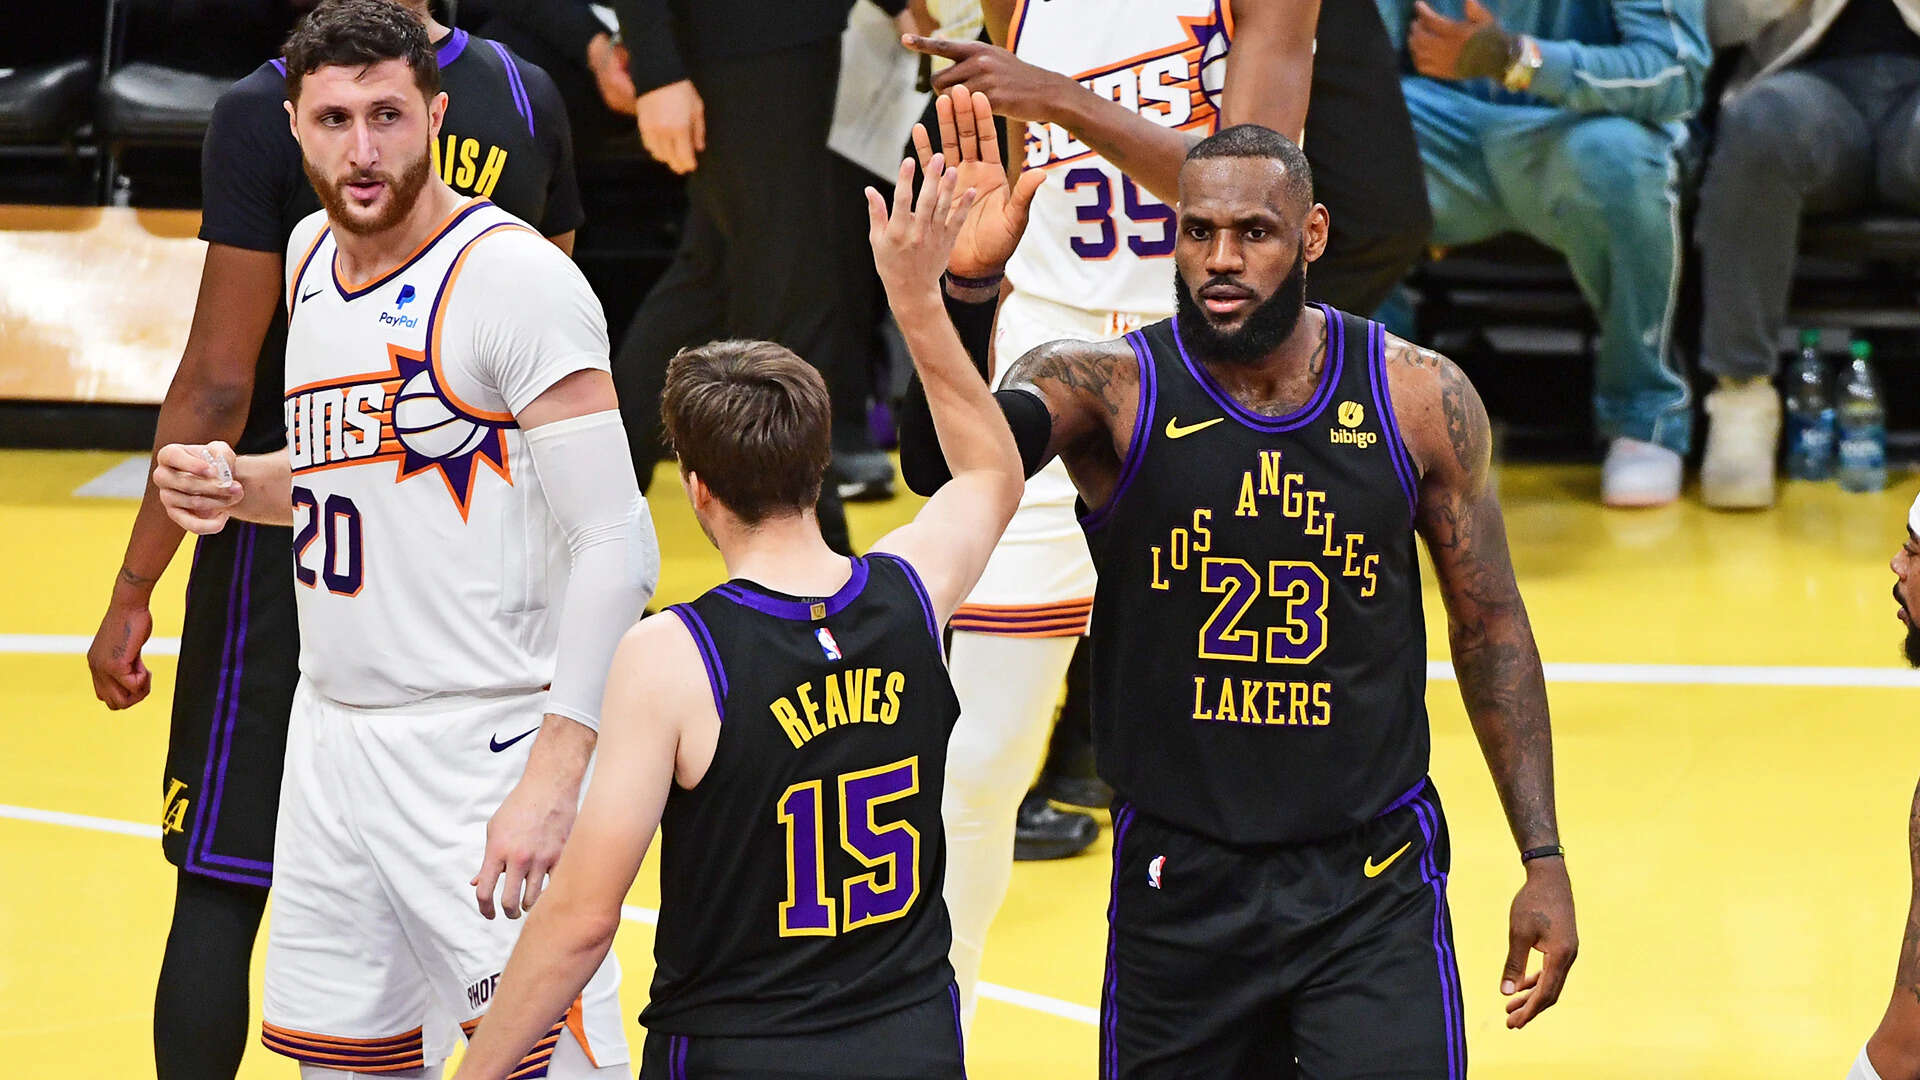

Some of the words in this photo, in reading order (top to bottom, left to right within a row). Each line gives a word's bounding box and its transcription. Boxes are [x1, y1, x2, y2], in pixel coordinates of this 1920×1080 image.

[1064, 168, 1177, 260] 35
[379, 312, 418, 329] PayPal
[285, 383, 385, 471] UNS
[1329, 428, 1377, 449] bibigo
[291, 485, 365, 598] 20
[1150, 508, 1212, 590] LOS
[1235, 451, 1380, 597] ANGELES
[1198, 556, 1330, 665] 23
[769, 667, 906, 750] REAVES
[1192, 676, 1332, 726] LAKERS
[776, 754, 921, 938] 15
